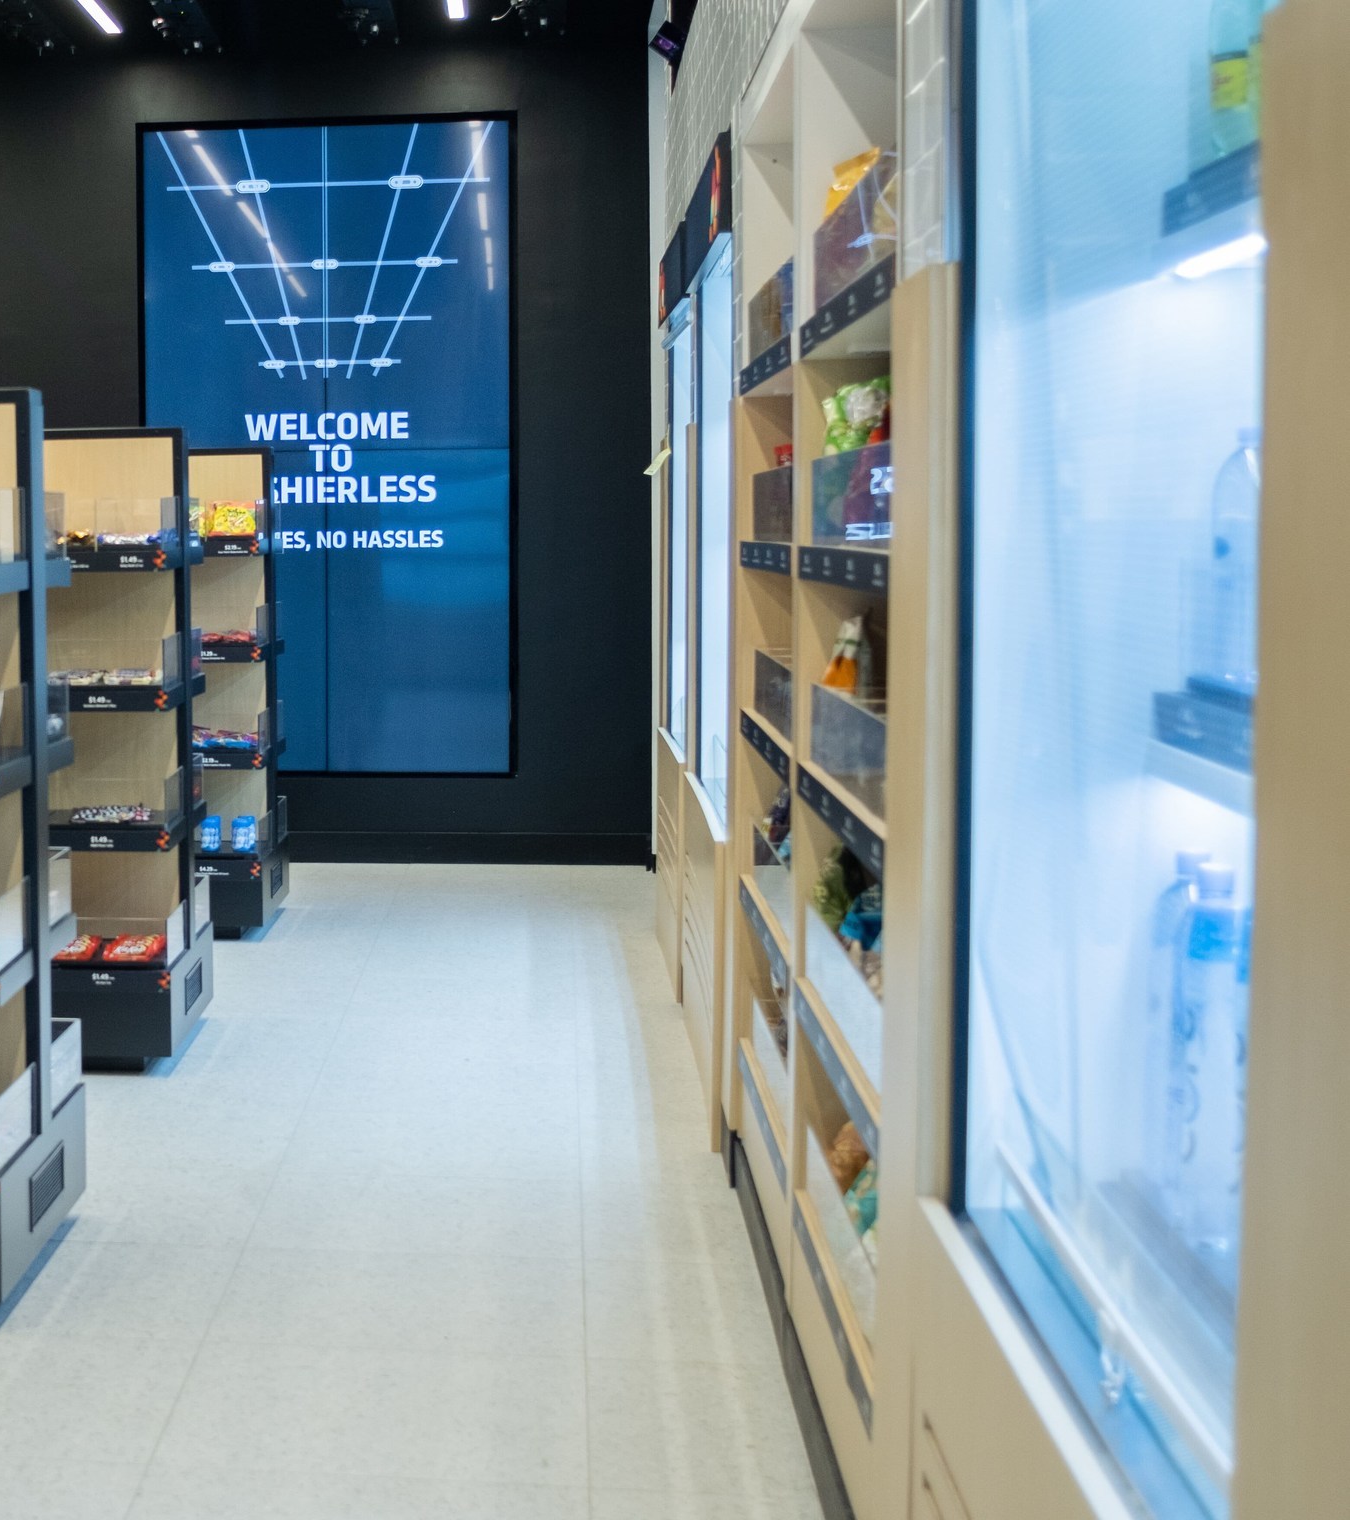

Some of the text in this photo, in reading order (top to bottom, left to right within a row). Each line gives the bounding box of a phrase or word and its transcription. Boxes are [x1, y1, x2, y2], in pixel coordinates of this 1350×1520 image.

[244, 411, 409, 441] WELCOME
[308, 443, 353, 472] TO
[275, 529, 444, 551] ES, NO HASSLES
